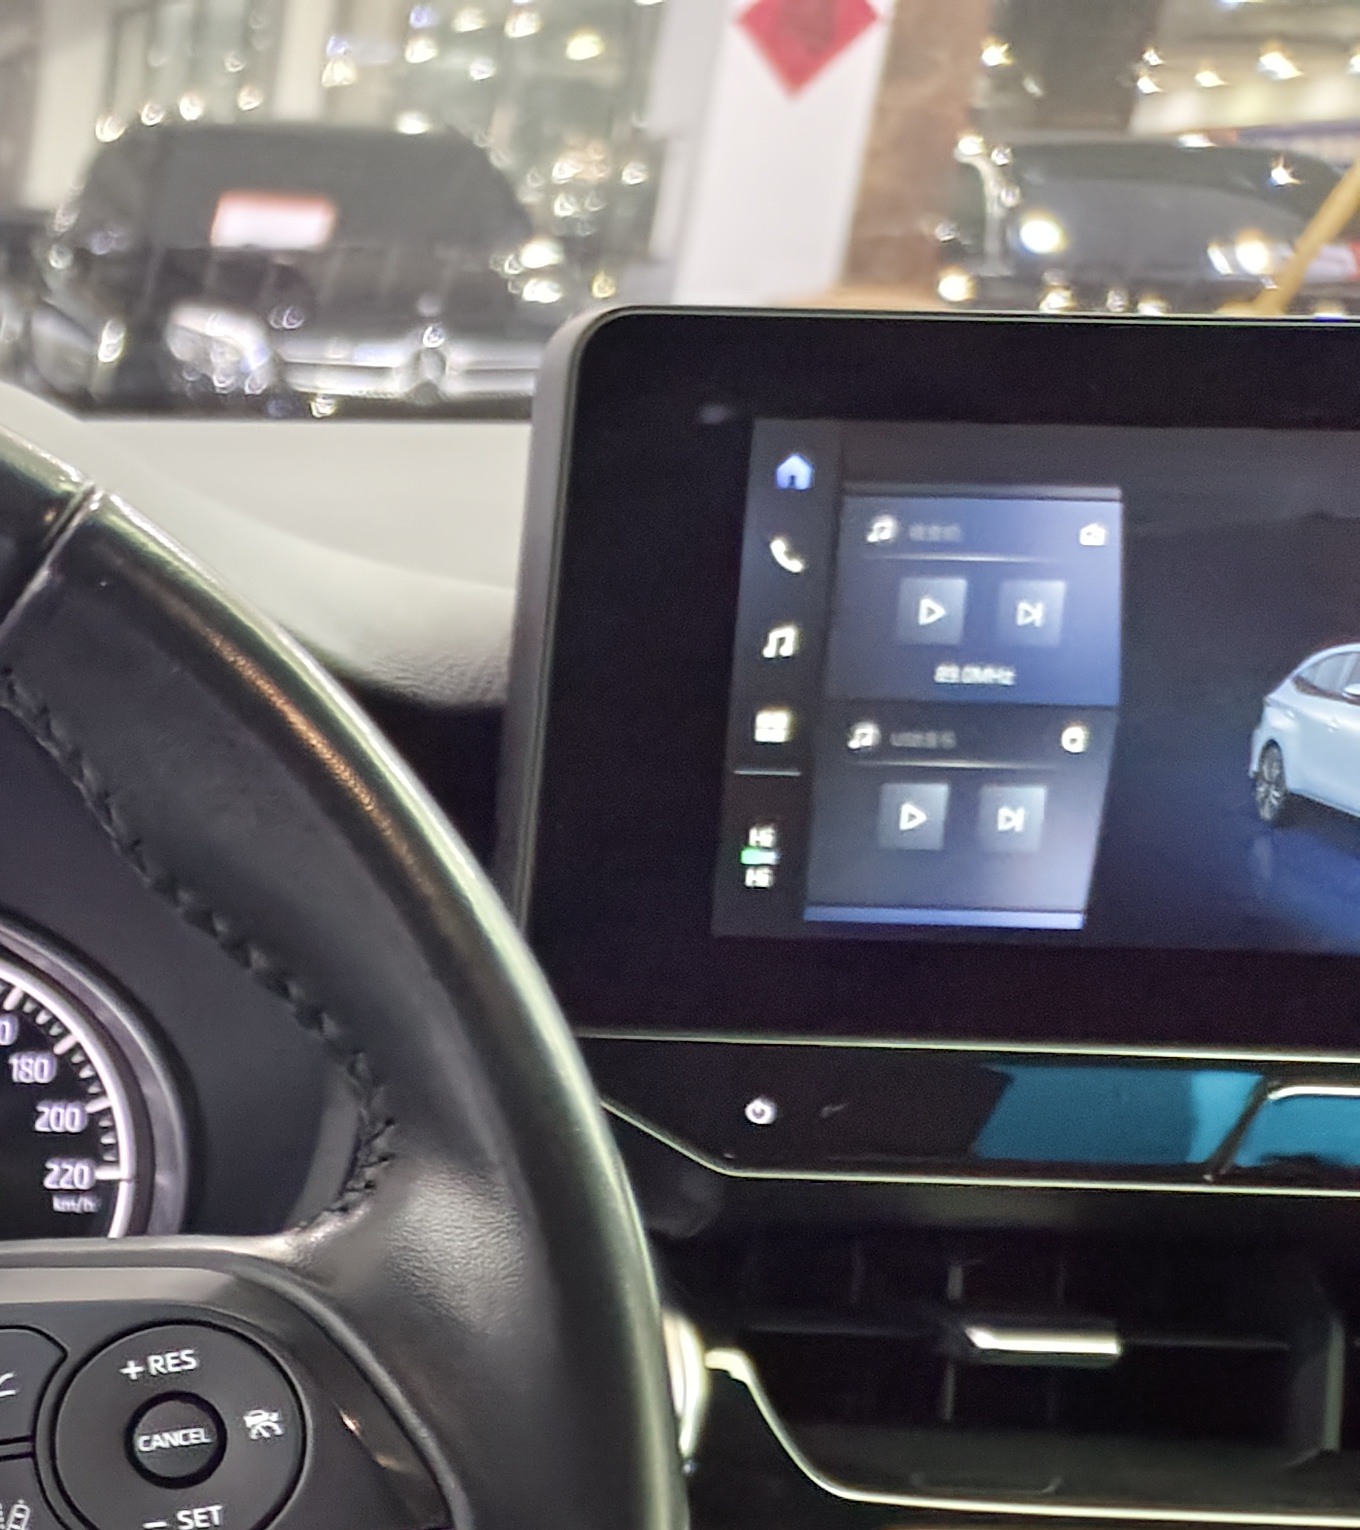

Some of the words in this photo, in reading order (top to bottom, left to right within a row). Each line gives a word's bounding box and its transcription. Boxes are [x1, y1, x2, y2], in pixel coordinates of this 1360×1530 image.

[9, 1053, 55, 1083] 180
[34, 1102, 85, 1134] 200
[44, 1160, 95, 1190] 220
[137, 1427, 212, 1453] CANCEL
